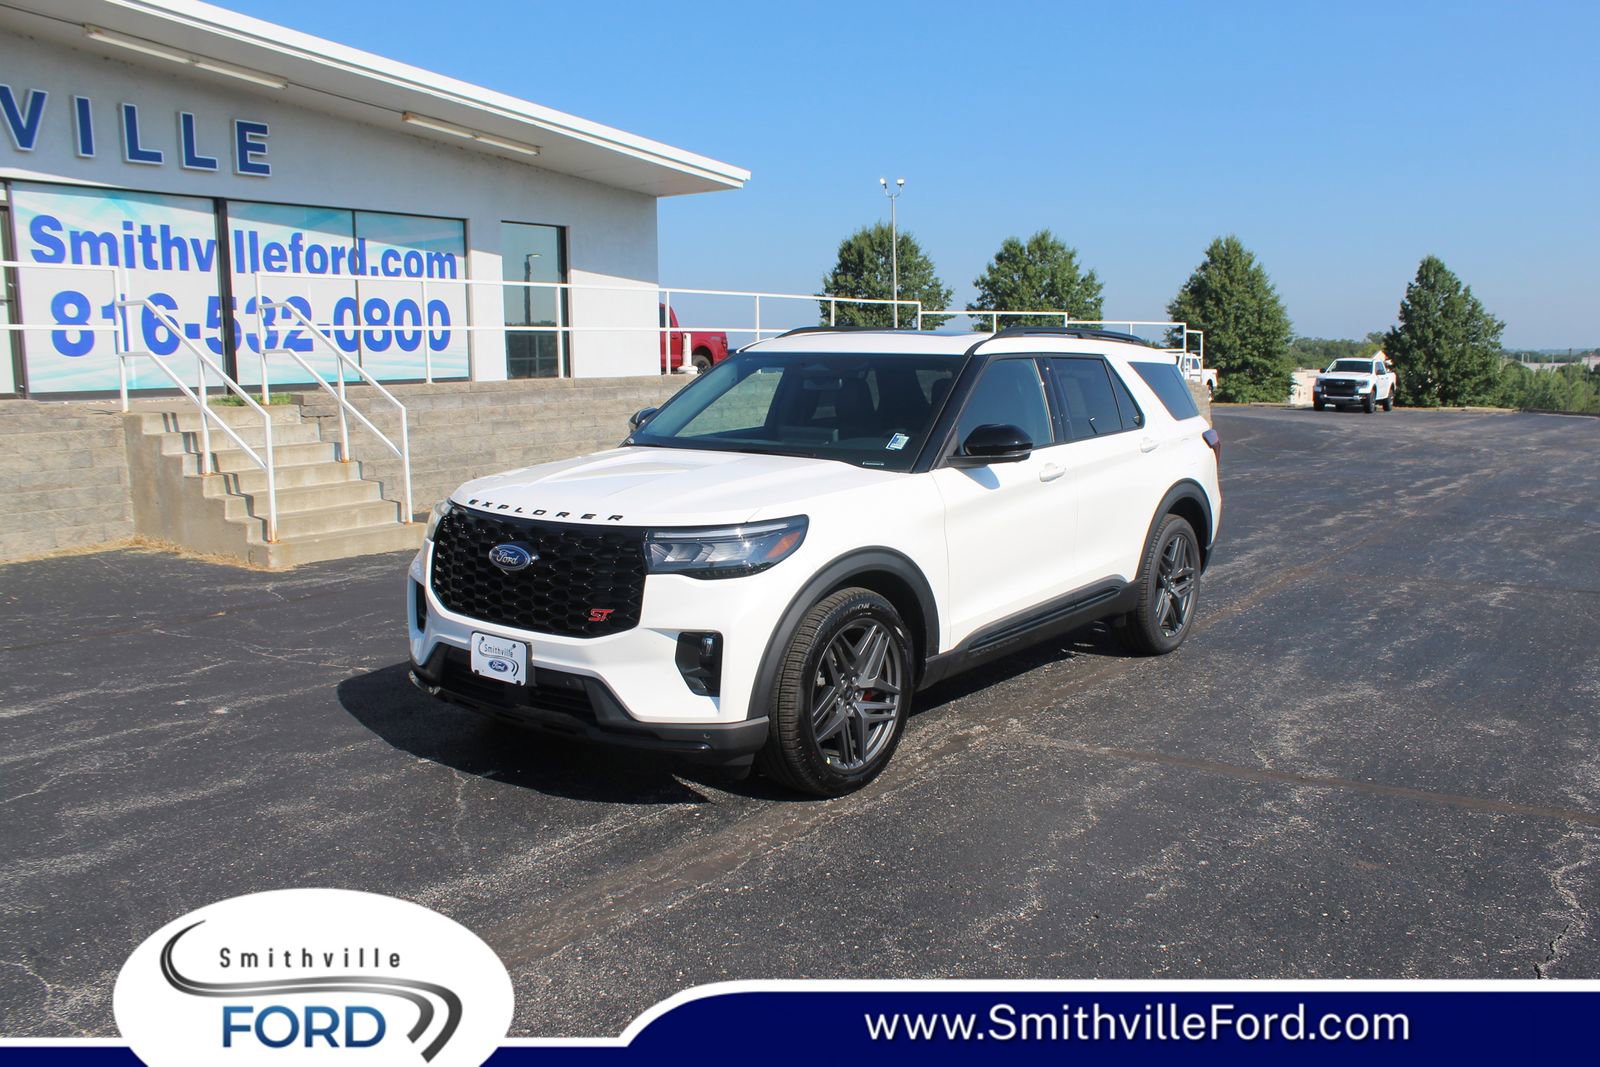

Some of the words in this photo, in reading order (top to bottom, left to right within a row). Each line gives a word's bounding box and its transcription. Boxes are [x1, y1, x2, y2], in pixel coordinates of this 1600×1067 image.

[51, 290, 450, 358] 816-532-0800
[468, 499, 624, 521] EXPLORER
[495, 549, 518, 566] Ford
[588, 608, 615, 621] ST
